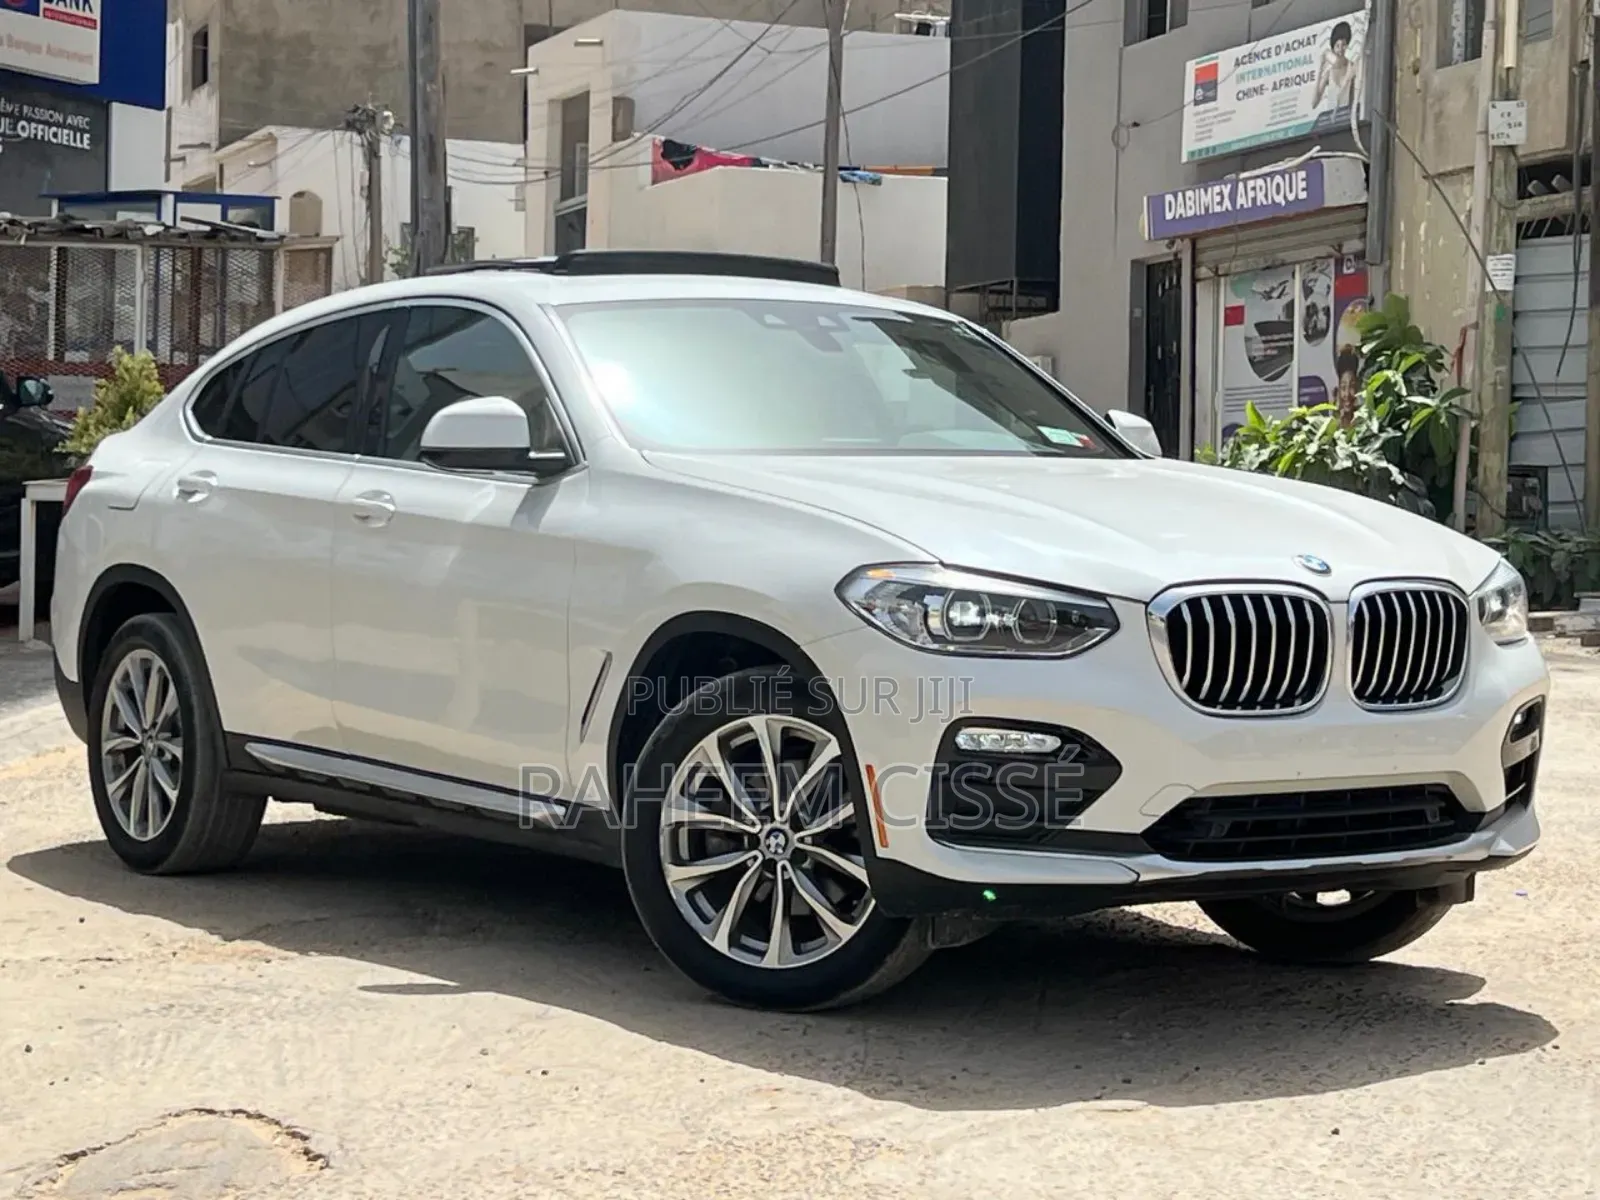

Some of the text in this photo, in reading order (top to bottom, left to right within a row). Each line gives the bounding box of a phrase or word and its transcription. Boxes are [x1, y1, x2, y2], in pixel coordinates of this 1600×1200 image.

[1275, 34, 1317, 56] D'ACHAT
[1236, 53, 1314, 84] INTERNATIONAL
[1271, 70, 1316, 92] AFRIQUE
[23, 104, 63, 123] PASSION
[66, 114, 91, 129] AVEC
[17, 120, 91, 150] OFFICIELLE
[1164, 171, 1308, 220] DABIMEX AFRIQUE
